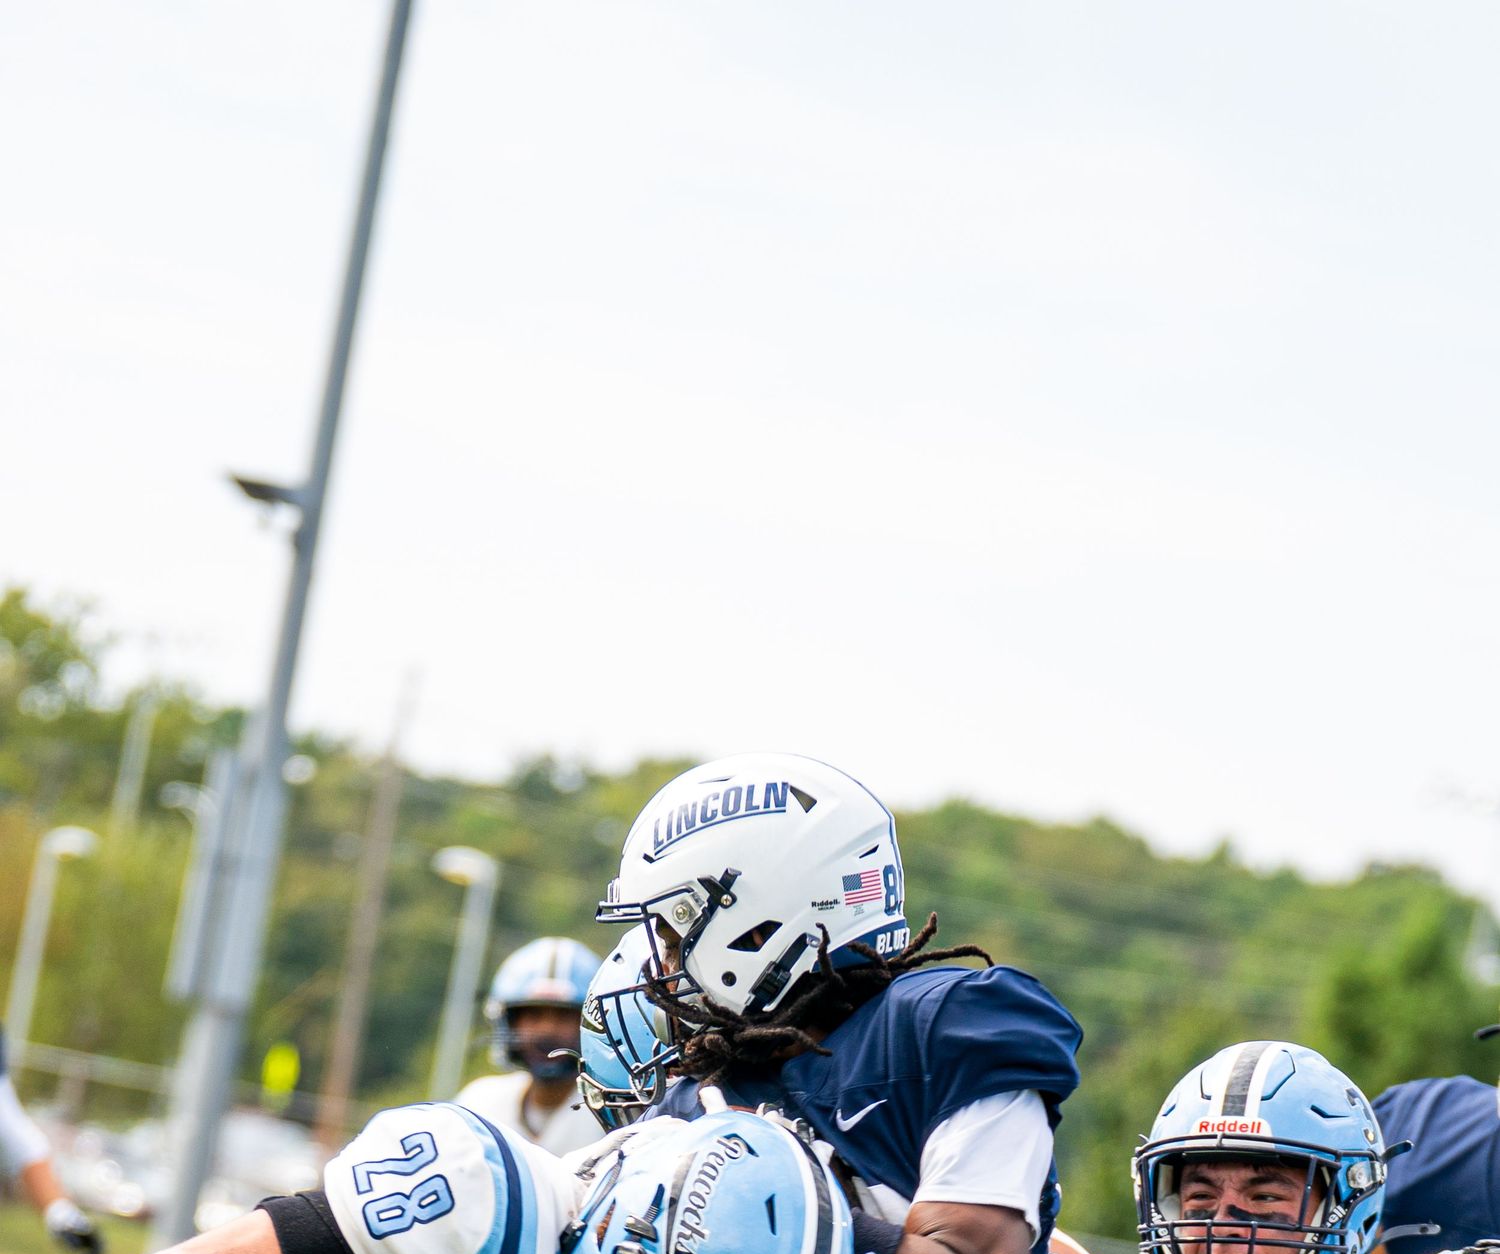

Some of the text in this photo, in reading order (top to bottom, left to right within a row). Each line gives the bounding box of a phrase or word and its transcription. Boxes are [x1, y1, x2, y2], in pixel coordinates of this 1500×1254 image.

[653, 781, 789, 851] LINCOLN
[1199, 1120, 1262, 1134] Riddell
[352, 1131, 455, 1240] 28
